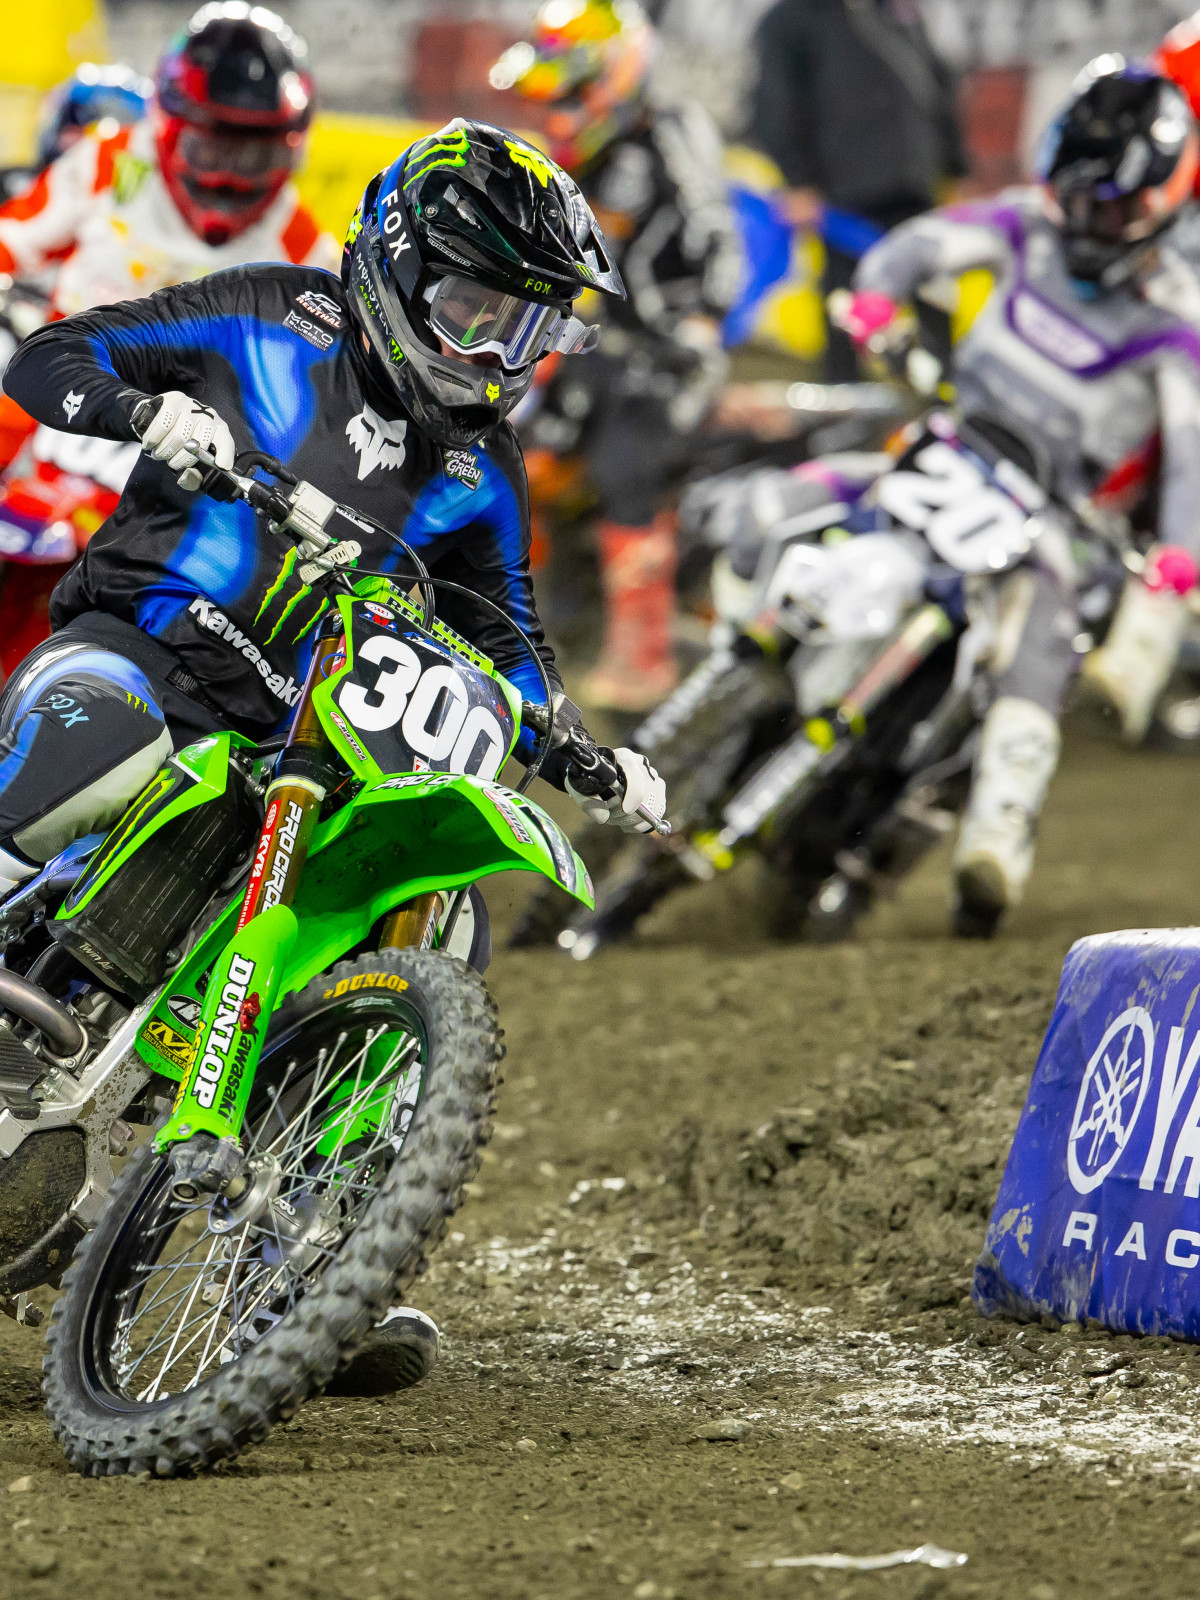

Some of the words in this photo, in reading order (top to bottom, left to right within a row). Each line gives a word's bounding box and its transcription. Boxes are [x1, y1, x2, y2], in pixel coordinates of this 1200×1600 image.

[381, 188, 412, 261] FOX
[359, 285, 376, 316] ARMY
[524, 278, 552, 295] FOX
[284, 310, 334, 344] MOTO
[295, 295, 342, 328] RENTHAL
[445, 450, 476, 467] TEAM
[447, 459, 481, 480] GREEN
[188, 597, 305, 707] Kawasaki
[45, 693, 90, 729] FOX
[338, 635, 505, 782] 300
[278, 800, 303, 855] PRO
[261, 849, 291, 914] CIRC
[237, 882, 255, 933] suspensio
[79, 941, 102, 961] Twin
[332, 972, 410, 998] DUNLOP
[191, 952, 256, 1110] DUNLOP
[170, 1053, 188, 1070] WEA
[218, 1024, 261, 1124] Kawasaki
